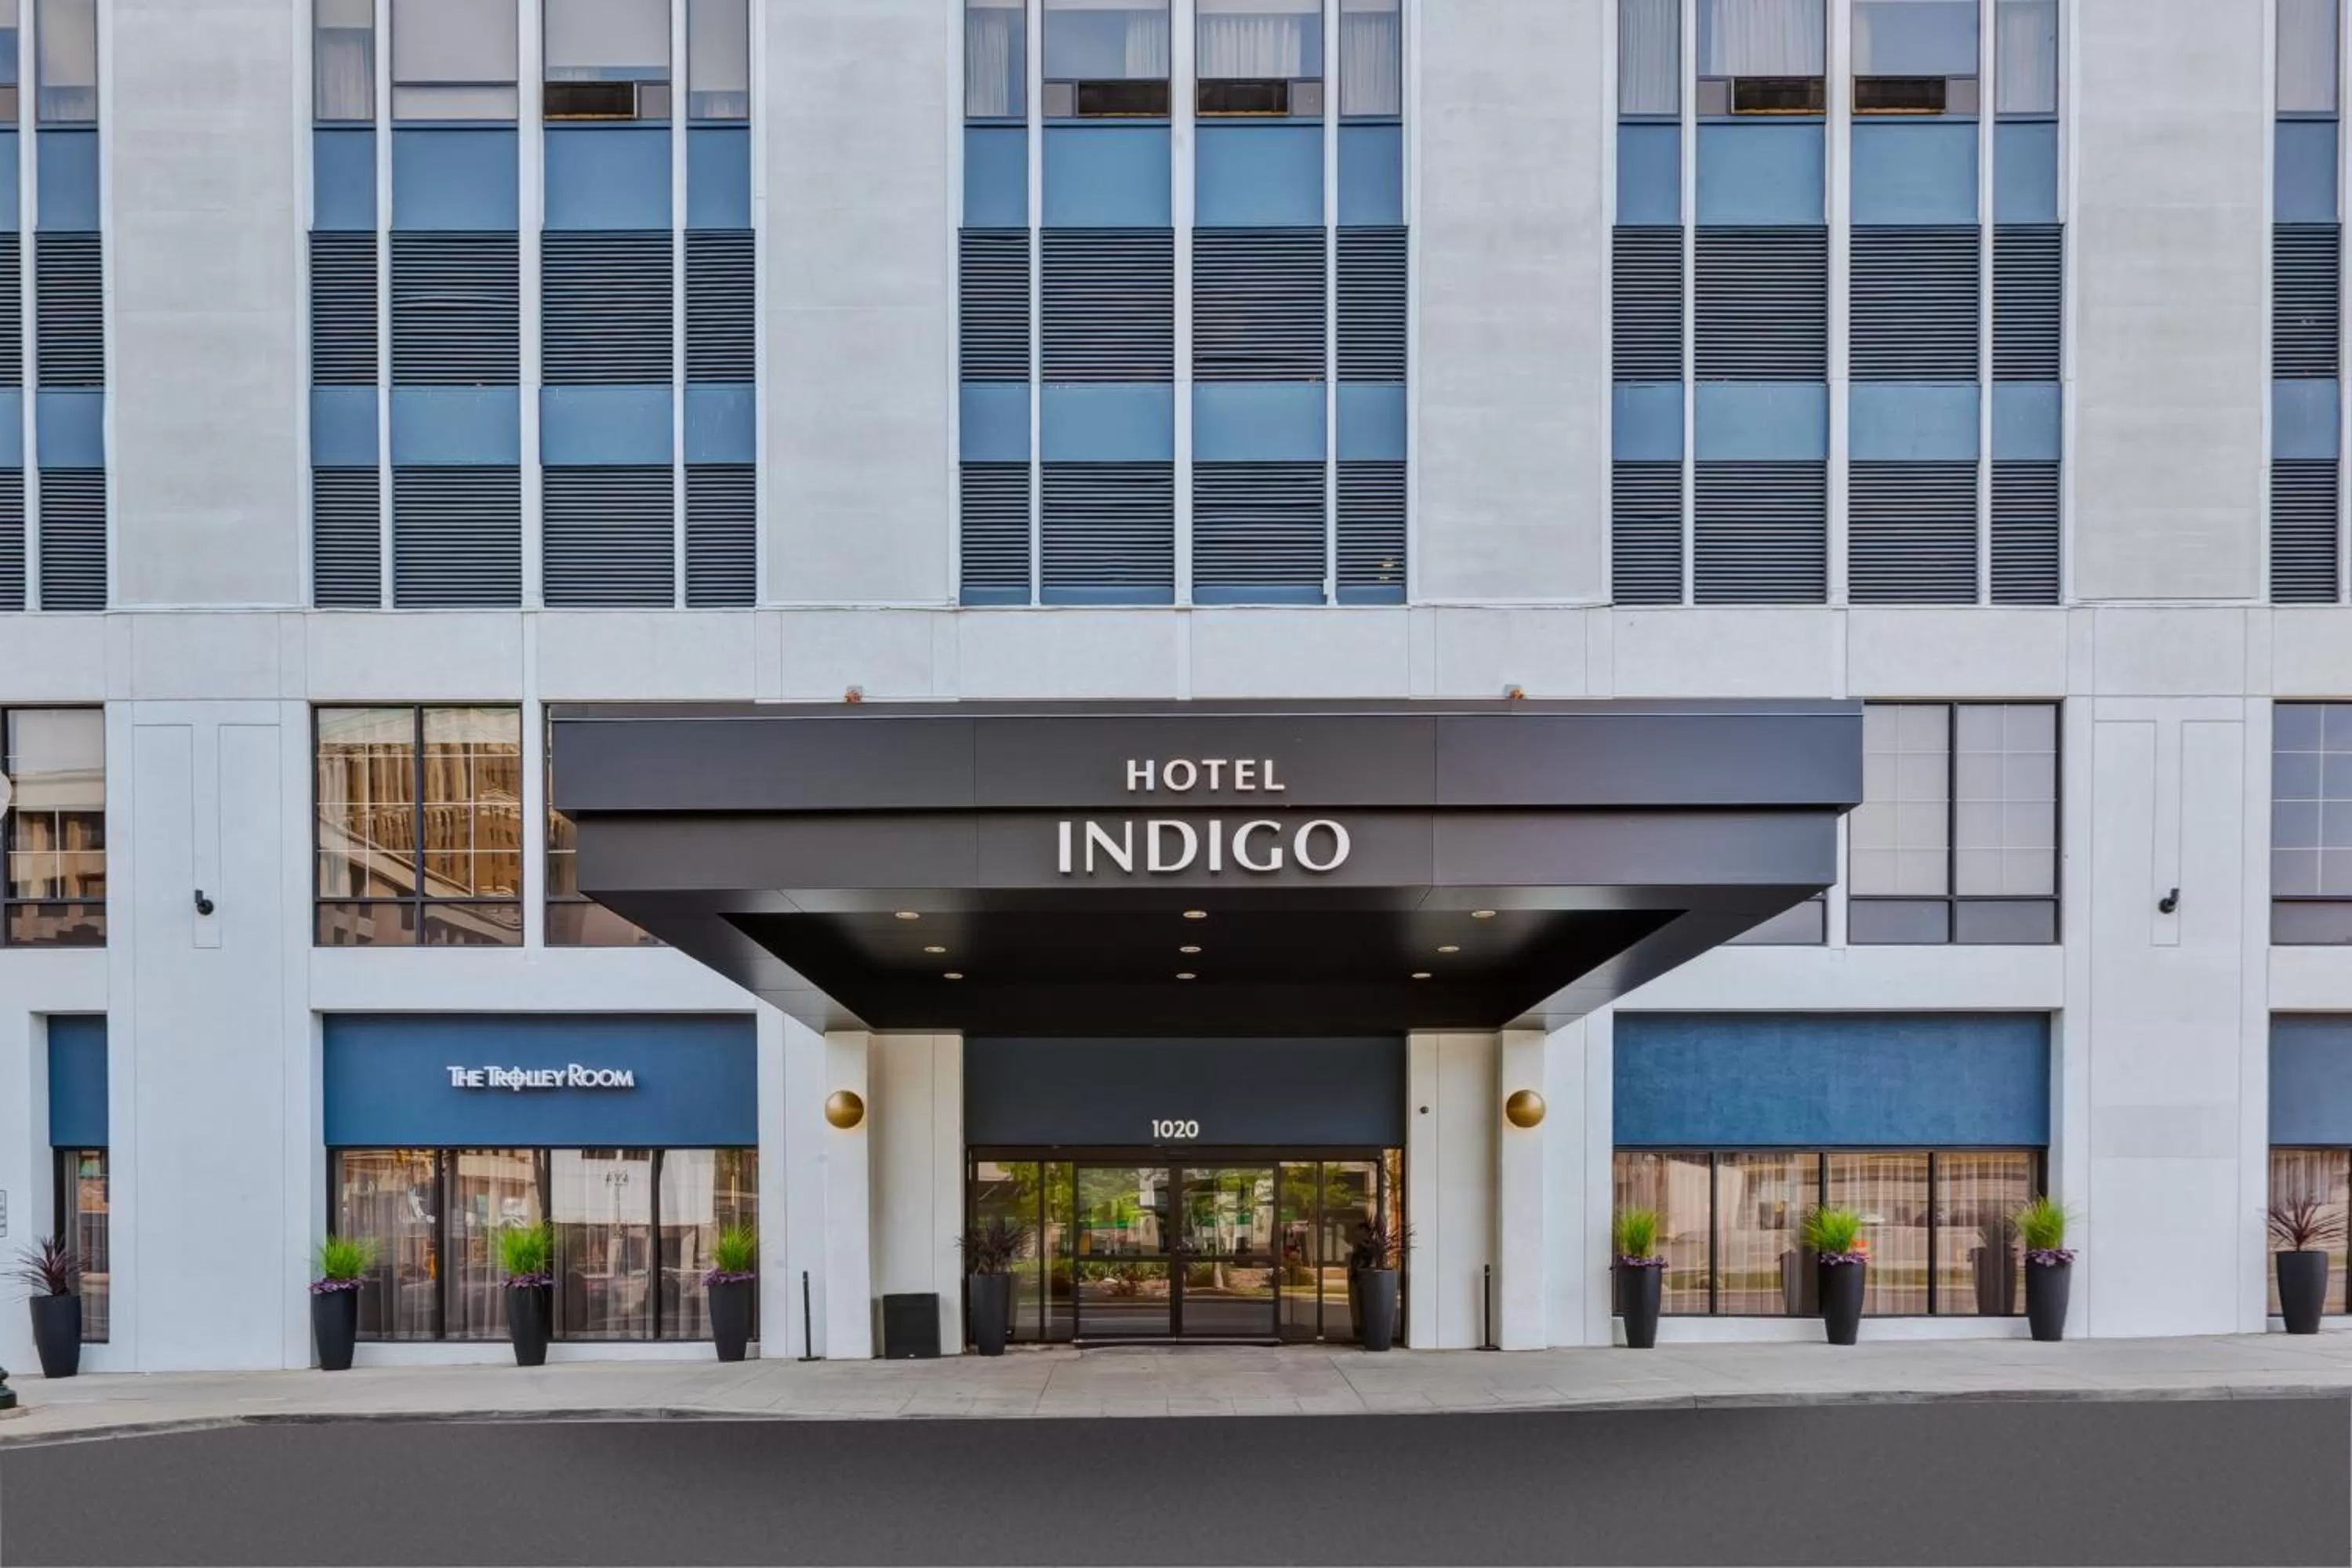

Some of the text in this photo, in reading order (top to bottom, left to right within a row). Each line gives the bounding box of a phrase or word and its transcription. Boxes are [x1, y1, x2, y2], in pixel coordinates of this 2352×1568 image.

[1127, 759, 1286, 792] HOTEL
[1058, 818, 1351, 873] INDIGO
[446, 1063, 635, 1091] THE TROLLEY ROOM
[1151, 1120, 1200, 1138] 1020
